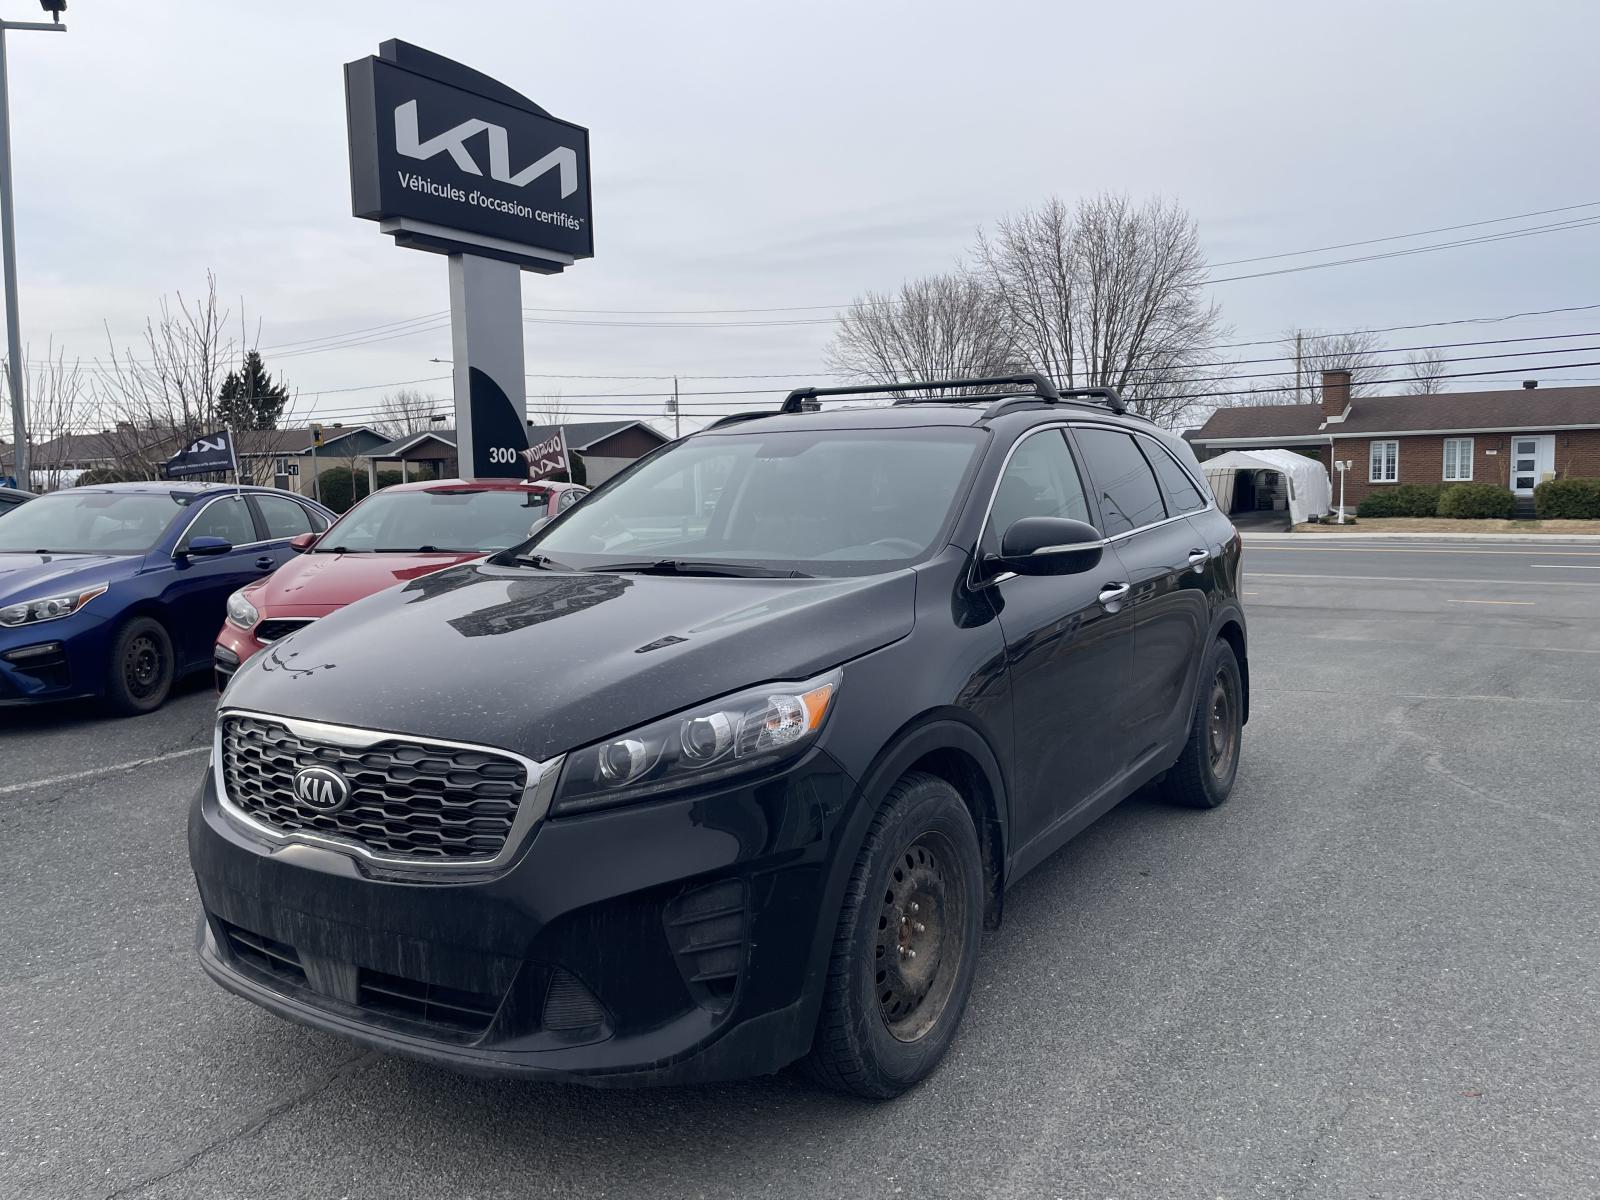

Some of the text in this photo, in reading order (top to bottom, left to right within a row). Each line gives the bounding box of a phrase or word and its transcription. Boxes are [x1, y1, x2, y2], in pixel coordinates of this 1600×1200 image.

[395, 98, 577, 200] KIA
[398, 171, 466, 202] Véhicules
[535, 209, 580, 231] certifiés
[489, 447, 517, 464] 300
[300, 775, 336, 804] KIA
